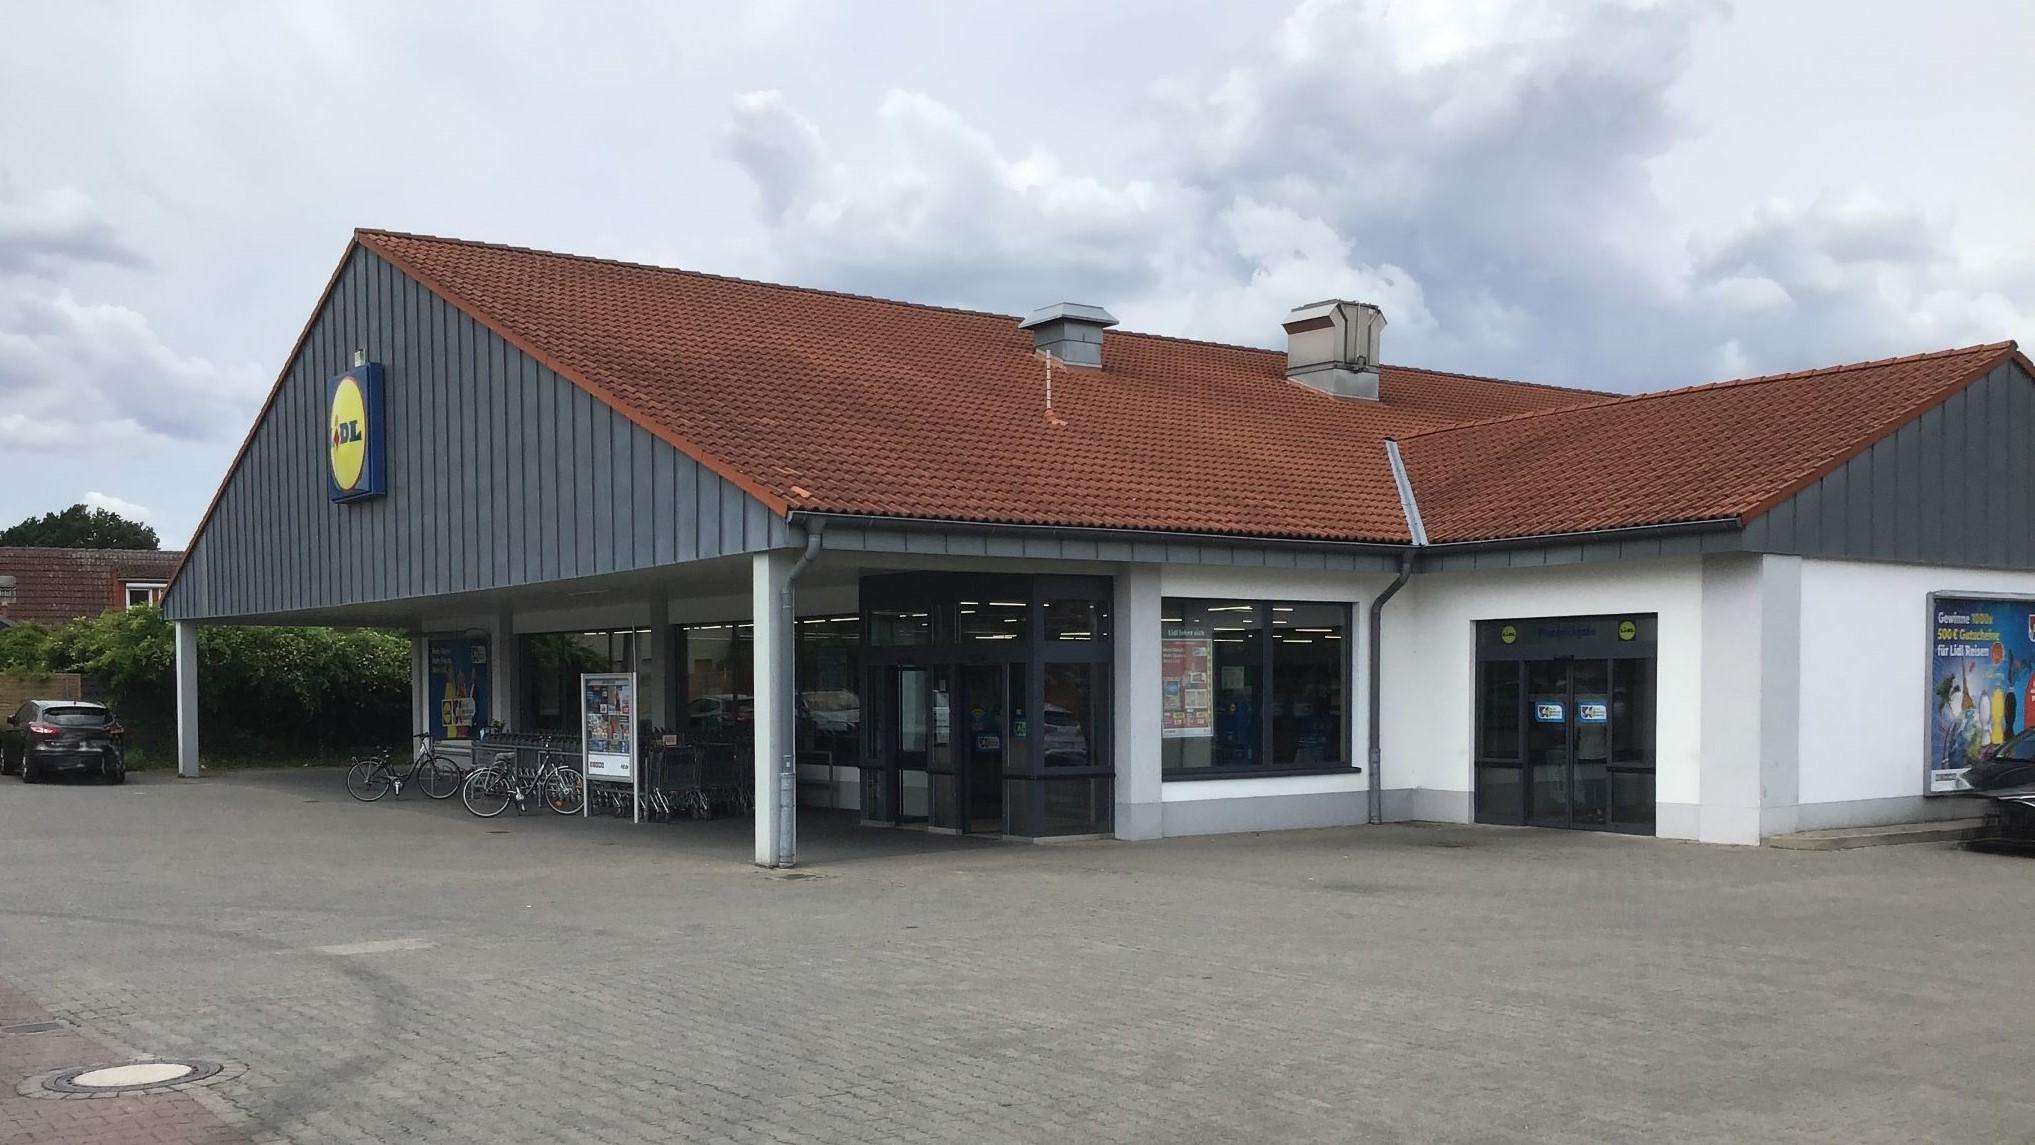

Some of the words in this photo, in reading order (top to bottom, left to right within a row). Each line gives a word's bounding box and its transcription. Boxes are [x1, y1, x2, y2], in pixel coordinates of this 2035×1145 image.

[1938, 612, 1970, 624] Gewinne
[1937, 628, 1953, 640] 500
[1953, 628, 1958, 640] €
[1937, 644, 1948, 657] für
[1950, 644, 1964, 657] Lidl
[1965, 644, 1989, 657] Reisen
